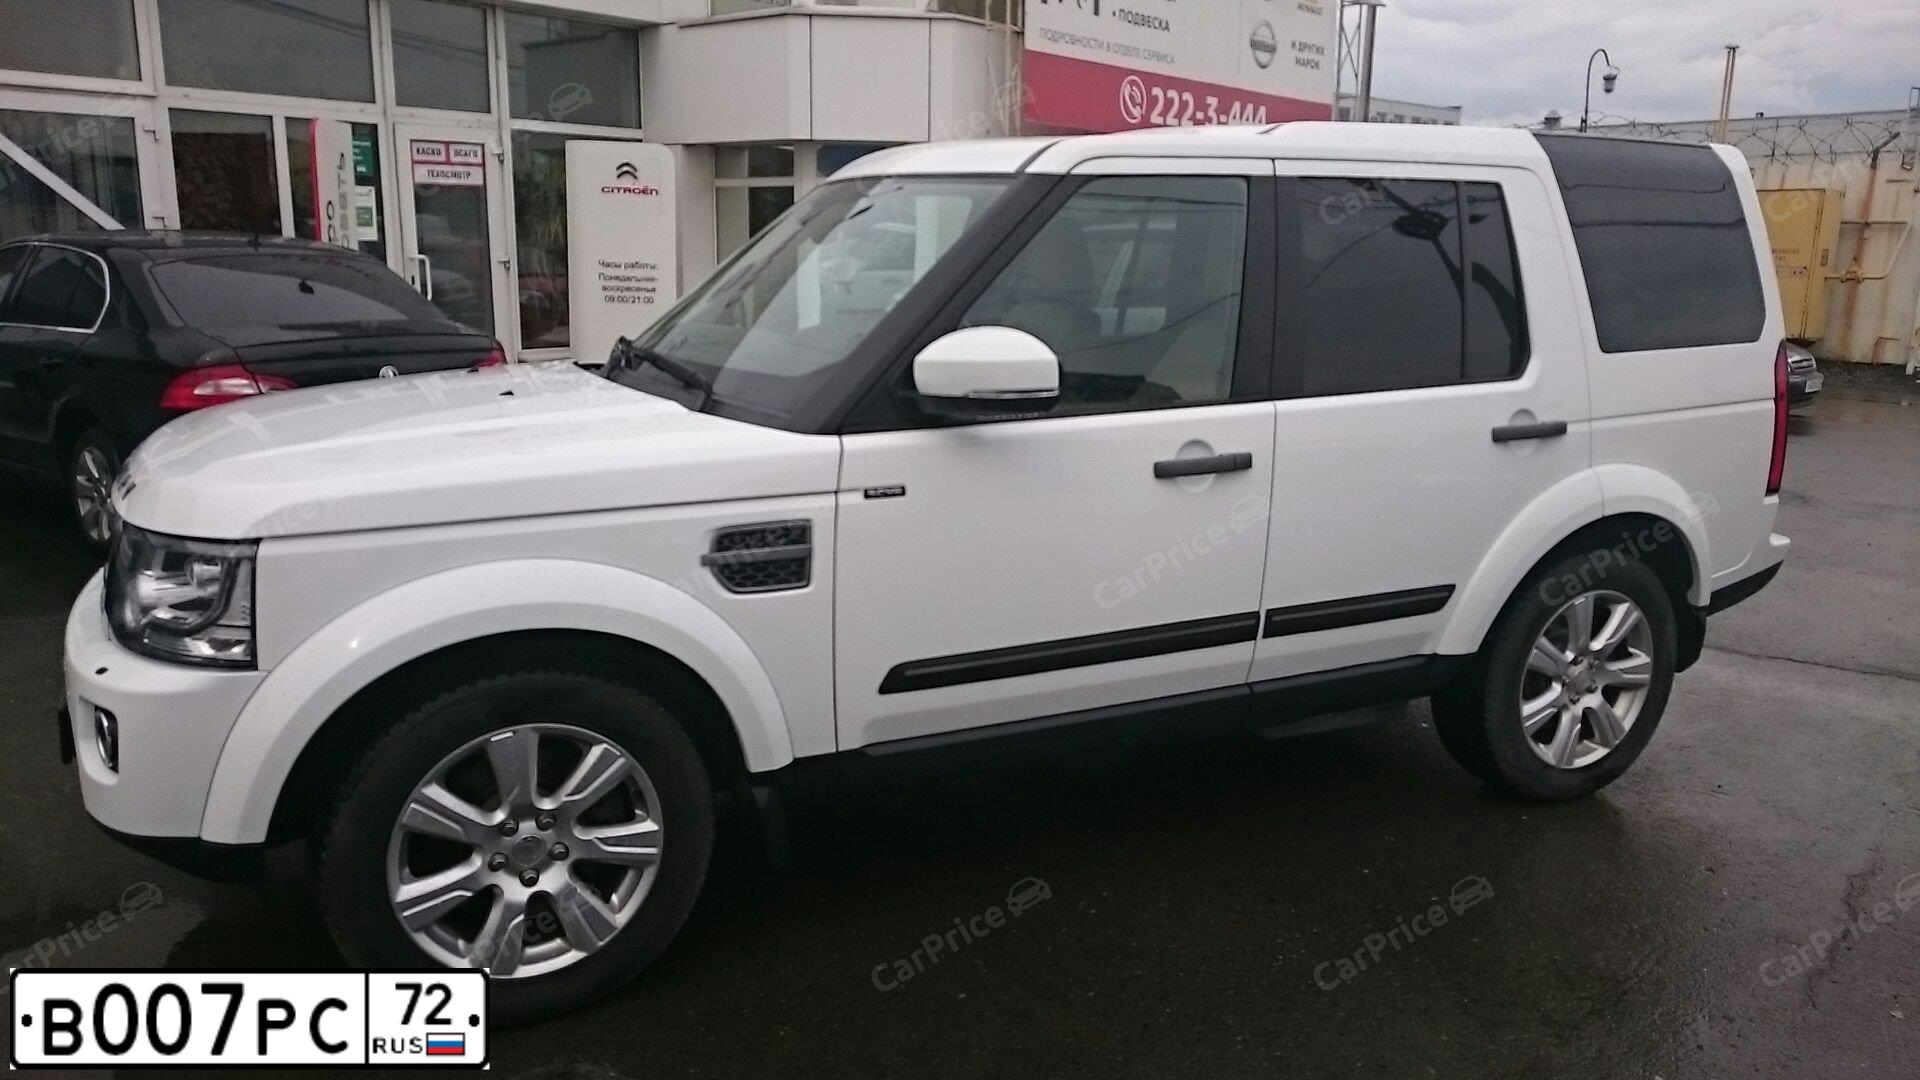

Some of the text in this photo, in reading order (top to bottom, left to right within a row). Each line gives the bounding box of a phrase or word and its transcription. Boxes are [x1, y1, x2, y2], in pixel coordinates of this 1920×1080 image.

[1119, 8, 1171, 32] ПОДВЕСКА
[1151, 86, 1267, 126] 222-3-444
[598, 259, 622, 268] Часы
